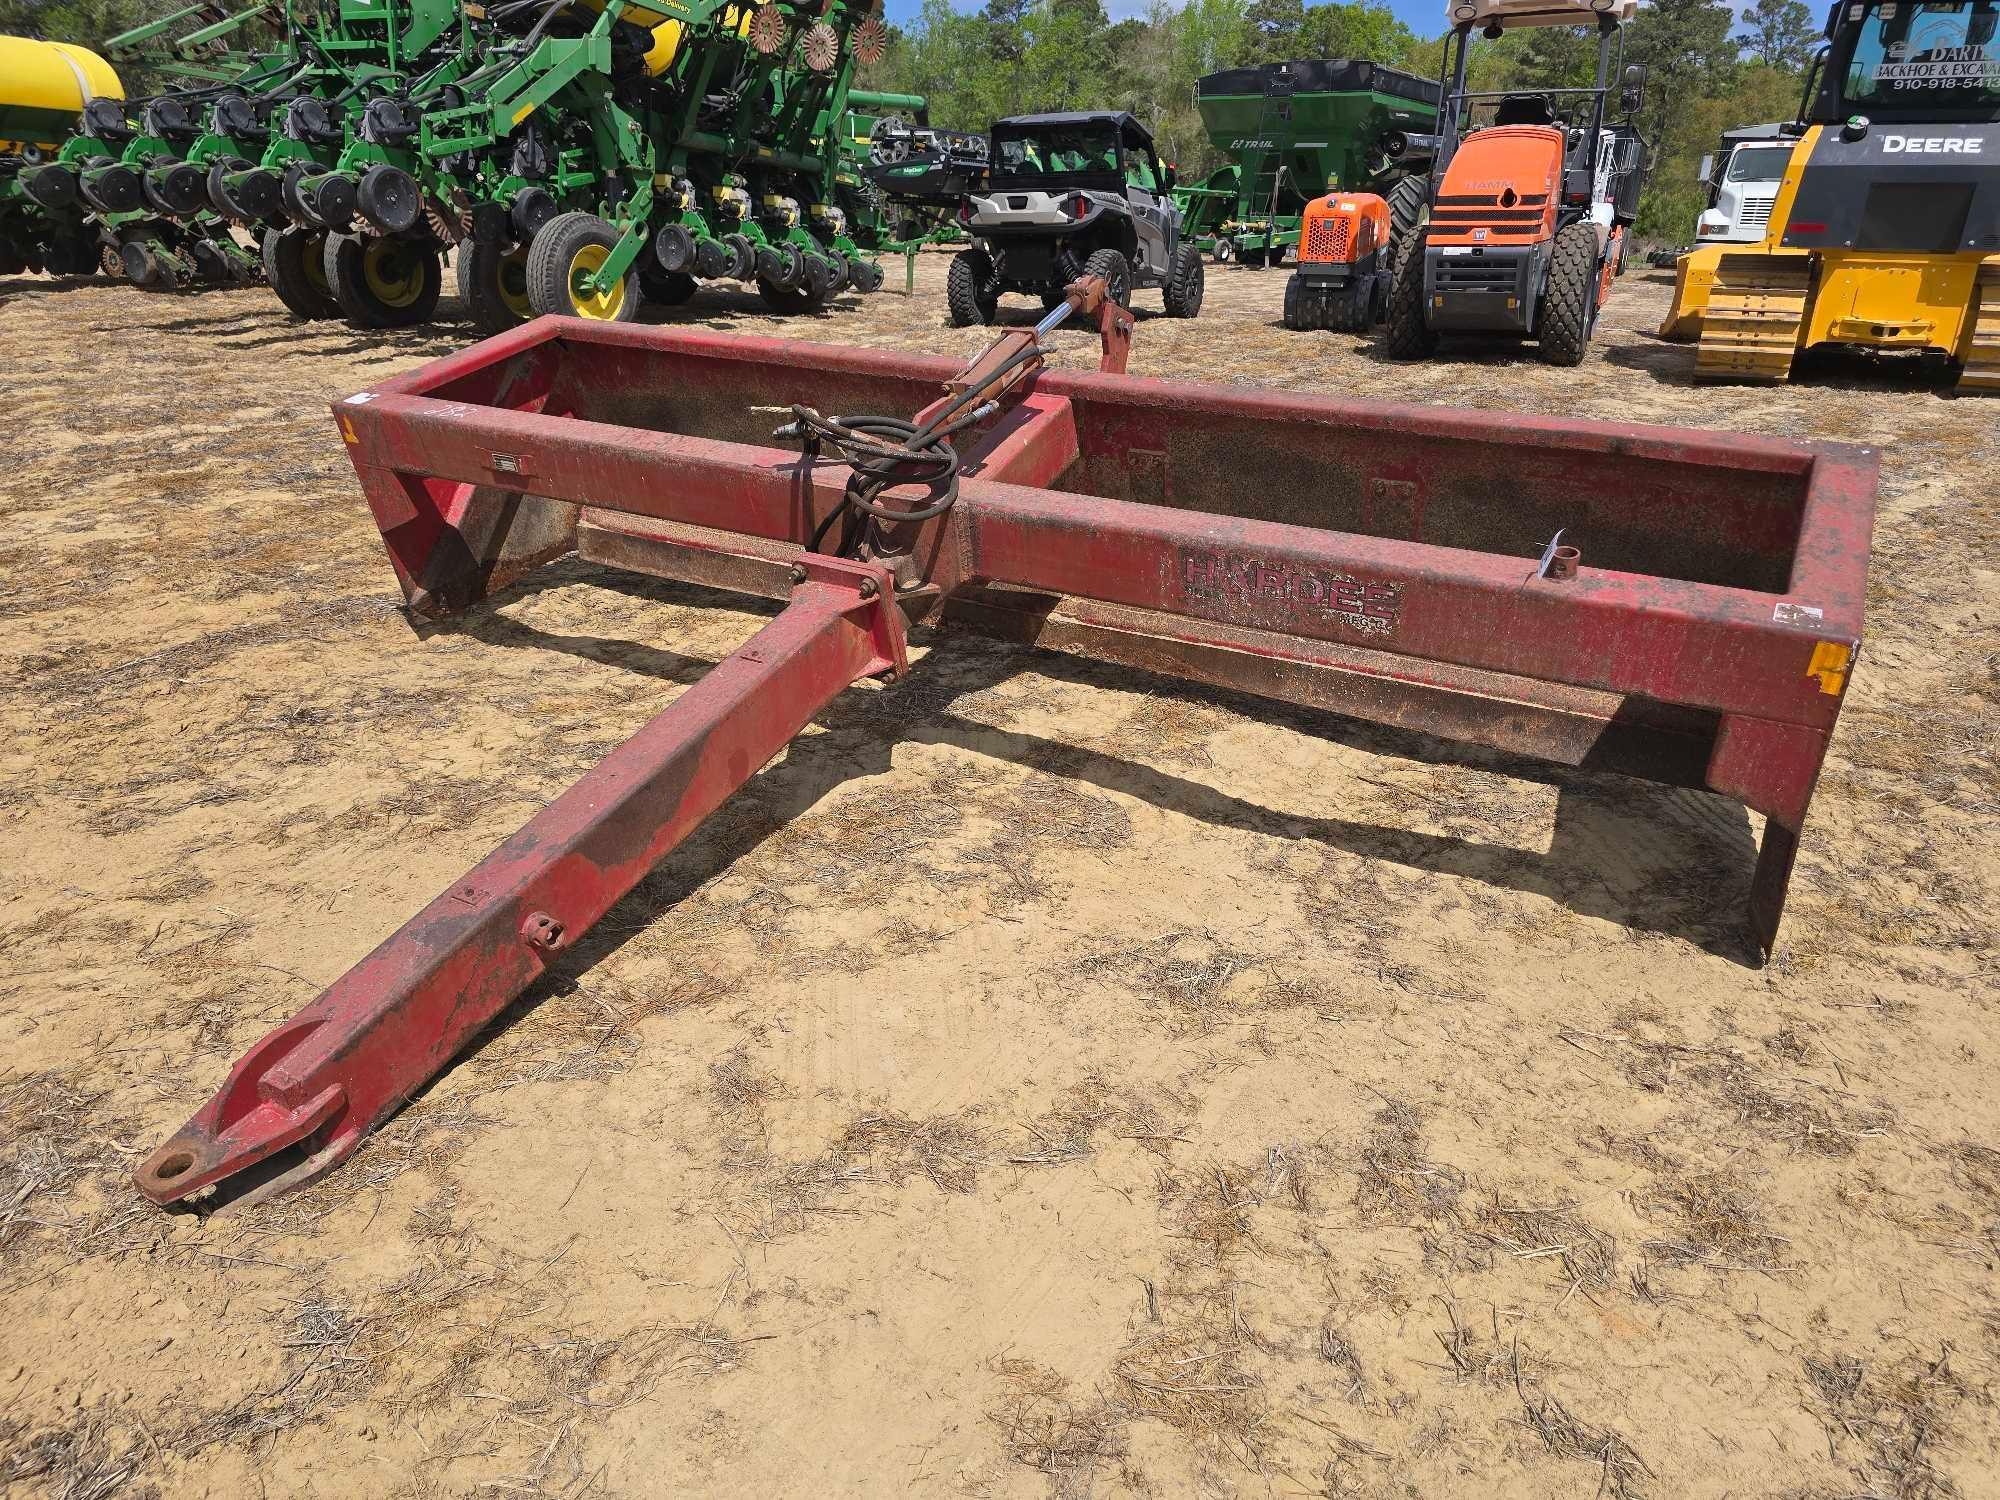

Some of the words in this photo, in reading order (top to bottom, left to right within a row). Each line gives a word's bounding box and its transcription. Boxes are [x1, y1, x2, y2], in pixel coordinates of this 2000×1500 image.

[1938, 64, 1949, 76] &
[1245, 139, 1274, 149] TRAIL
[1882, 135, 1983, 153] DEERE
